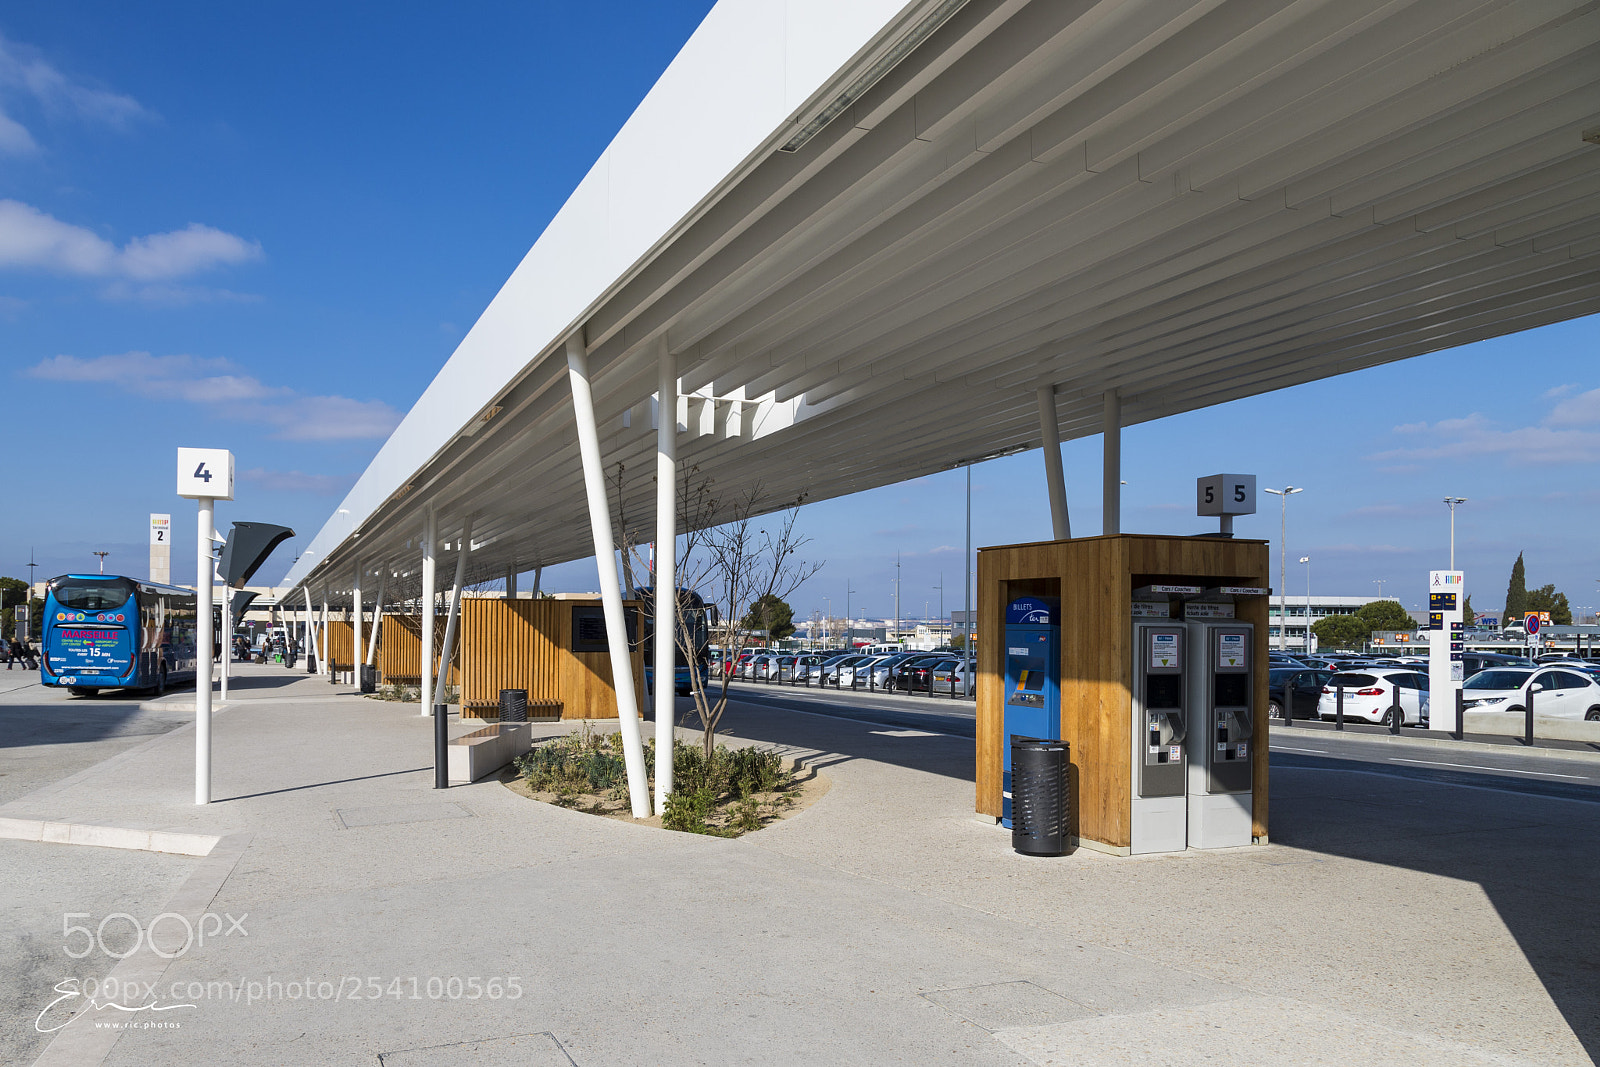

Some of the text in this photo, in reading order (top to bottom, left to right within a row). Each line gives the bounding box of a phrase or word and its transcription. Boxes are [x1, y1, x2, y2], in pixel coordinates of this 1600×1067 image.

[194, 462, 212, 482] 4
[1204, 486, 1215, 504] 5
[1234, 484, 1246, 503] 5
[157, 530, 164, 541] 2
[1012, 603, 1033, 611] BILLETS
[1481, 617, 1498, 625] WFS
[62, 630, 118, 639] MARSEILLE
[89, 647, 101, 657] 15
